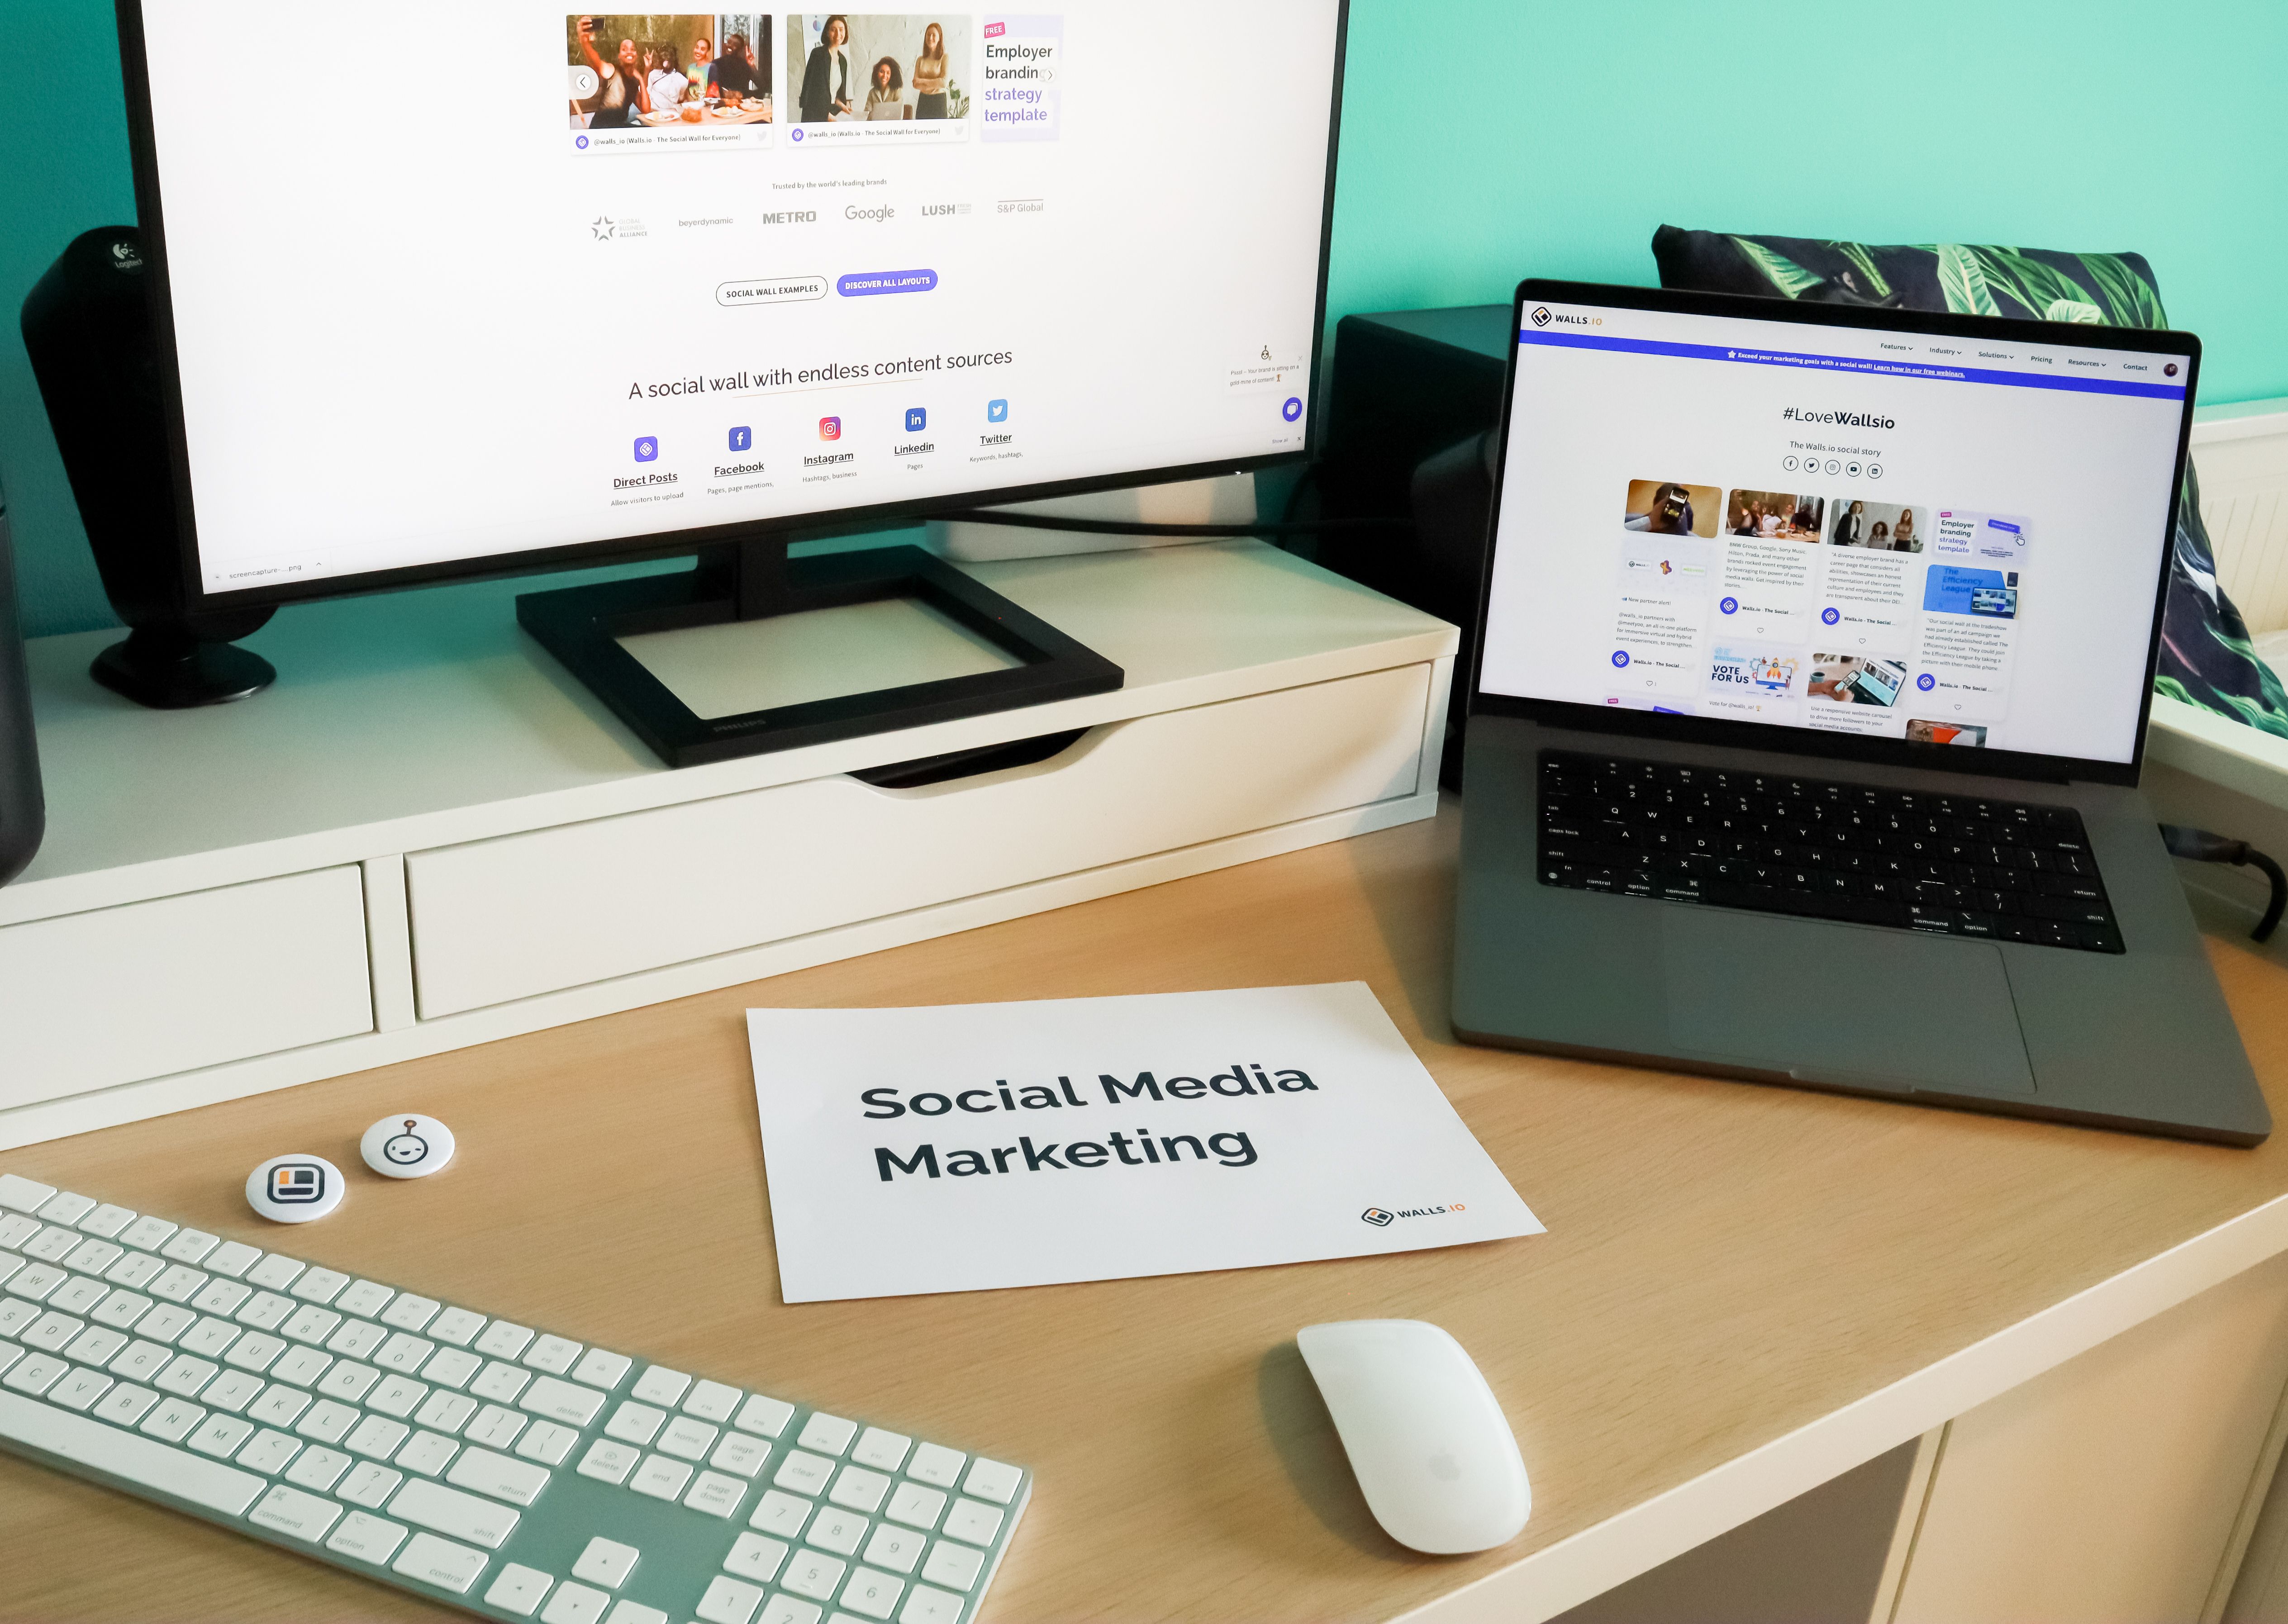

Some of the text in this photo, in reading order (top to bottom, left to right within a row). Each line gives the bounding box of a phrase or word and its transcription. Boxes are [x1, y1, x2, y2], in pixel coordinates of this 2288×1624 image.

[985, 25, 1003, 36] FREE
[986, 45, 1053, 62] Employer
[985, 87, 1042, 103] strategy
[984, 108, 1048, 124] template
[845, 204, 895, 223] Google
[922, 204, 956, 216] LUSH
[997, 202, 1044, 214] S&P Global
[678, 217, 733, 228] beyerdynamic
[762, 210, 817, 224] METRO
[845, 276, 930, 290] DISCOVER ALL LAYOUTS
[726, 290, 754, 298] SOCIAL
[779, 285, 818, 294] EXAMPLES
[1555, 314, 1603, 326] WALLS.IO
[1929, 347, 1955, 356] Industry
[1979, 351, 2007, 359] Solutions
[1773, 356, 1803, 364] marketing
[2031, 356, 2053, 364] Pricing
[2068, 359, 2099, 367] Resources
[628, 351, 1012, 399] A social wall with endless content sources
[1783, 407, 1895, 429] #LoveWallsio
[980, 433, 1012, 445] Twitter
[894, 442, 934, 454] Linkedin
[1806, 442, 1835, 451] Walls.io
[1861, 448, 1881, 457] story
[804, 452, 854, 466] Instagram
[970, 454, 997, 462] Keywords,
[714, 461, 765, 476] Facebook
[613, 472, 678, 489] Direct Posts
[662, 491, 683, 500] upload
[1941, 520, 1974, 529] Employer
[1940, 528, 1971, 538] branding
[1939, 537, 1968, 546] strategy
[1938, 545, 1969, 553] template
[1943, 576, 1983, 585] Efficiency
[1941, 584, 1971, 593] League
[1713, 665, 1740, 675] VOTE
[1712, 673, 1749, 684] FOR US
[1665, 888, 1699, 897] command
[861, 1063, 1319, 1120] Social Media
[874, 1128, 1258, 1182] Marketing
[1397, 1203, 1466, 1218] WALLS.IO
[674, 1431, 699, 1444] home
[498, 1484, 527, 1497] return
[258, 1509, 303, 1529] command
[474, 1527, 495, 1539] shift
[334, 1536, 365, 1551] option
[429, 1567, 464, 1584] control
